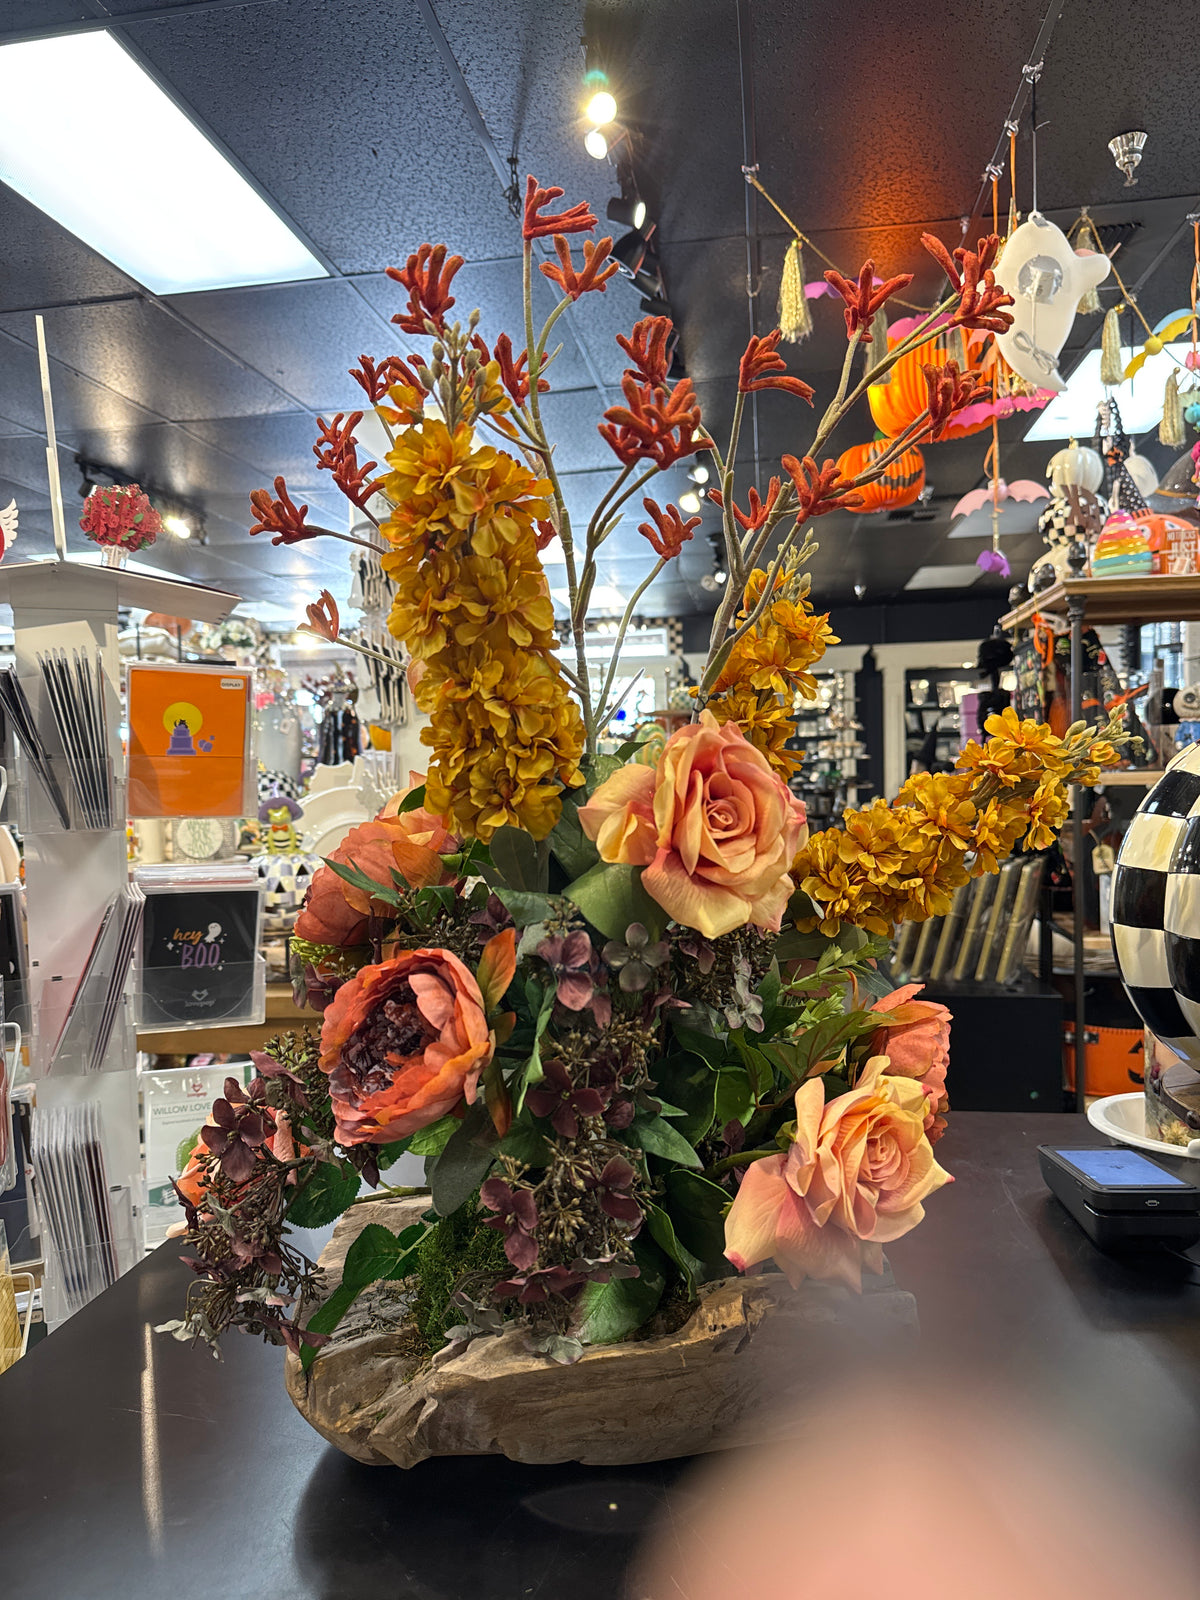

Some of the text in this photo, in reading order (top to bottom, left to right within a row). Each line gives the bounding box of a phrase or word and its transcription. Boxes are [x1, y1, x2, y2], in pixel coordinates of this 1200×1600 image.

[172, 928, 203, 945] hey
[181, 943, 220, 969] BOO
[152, 1101, 211, 1115] WILLOW LOVE
